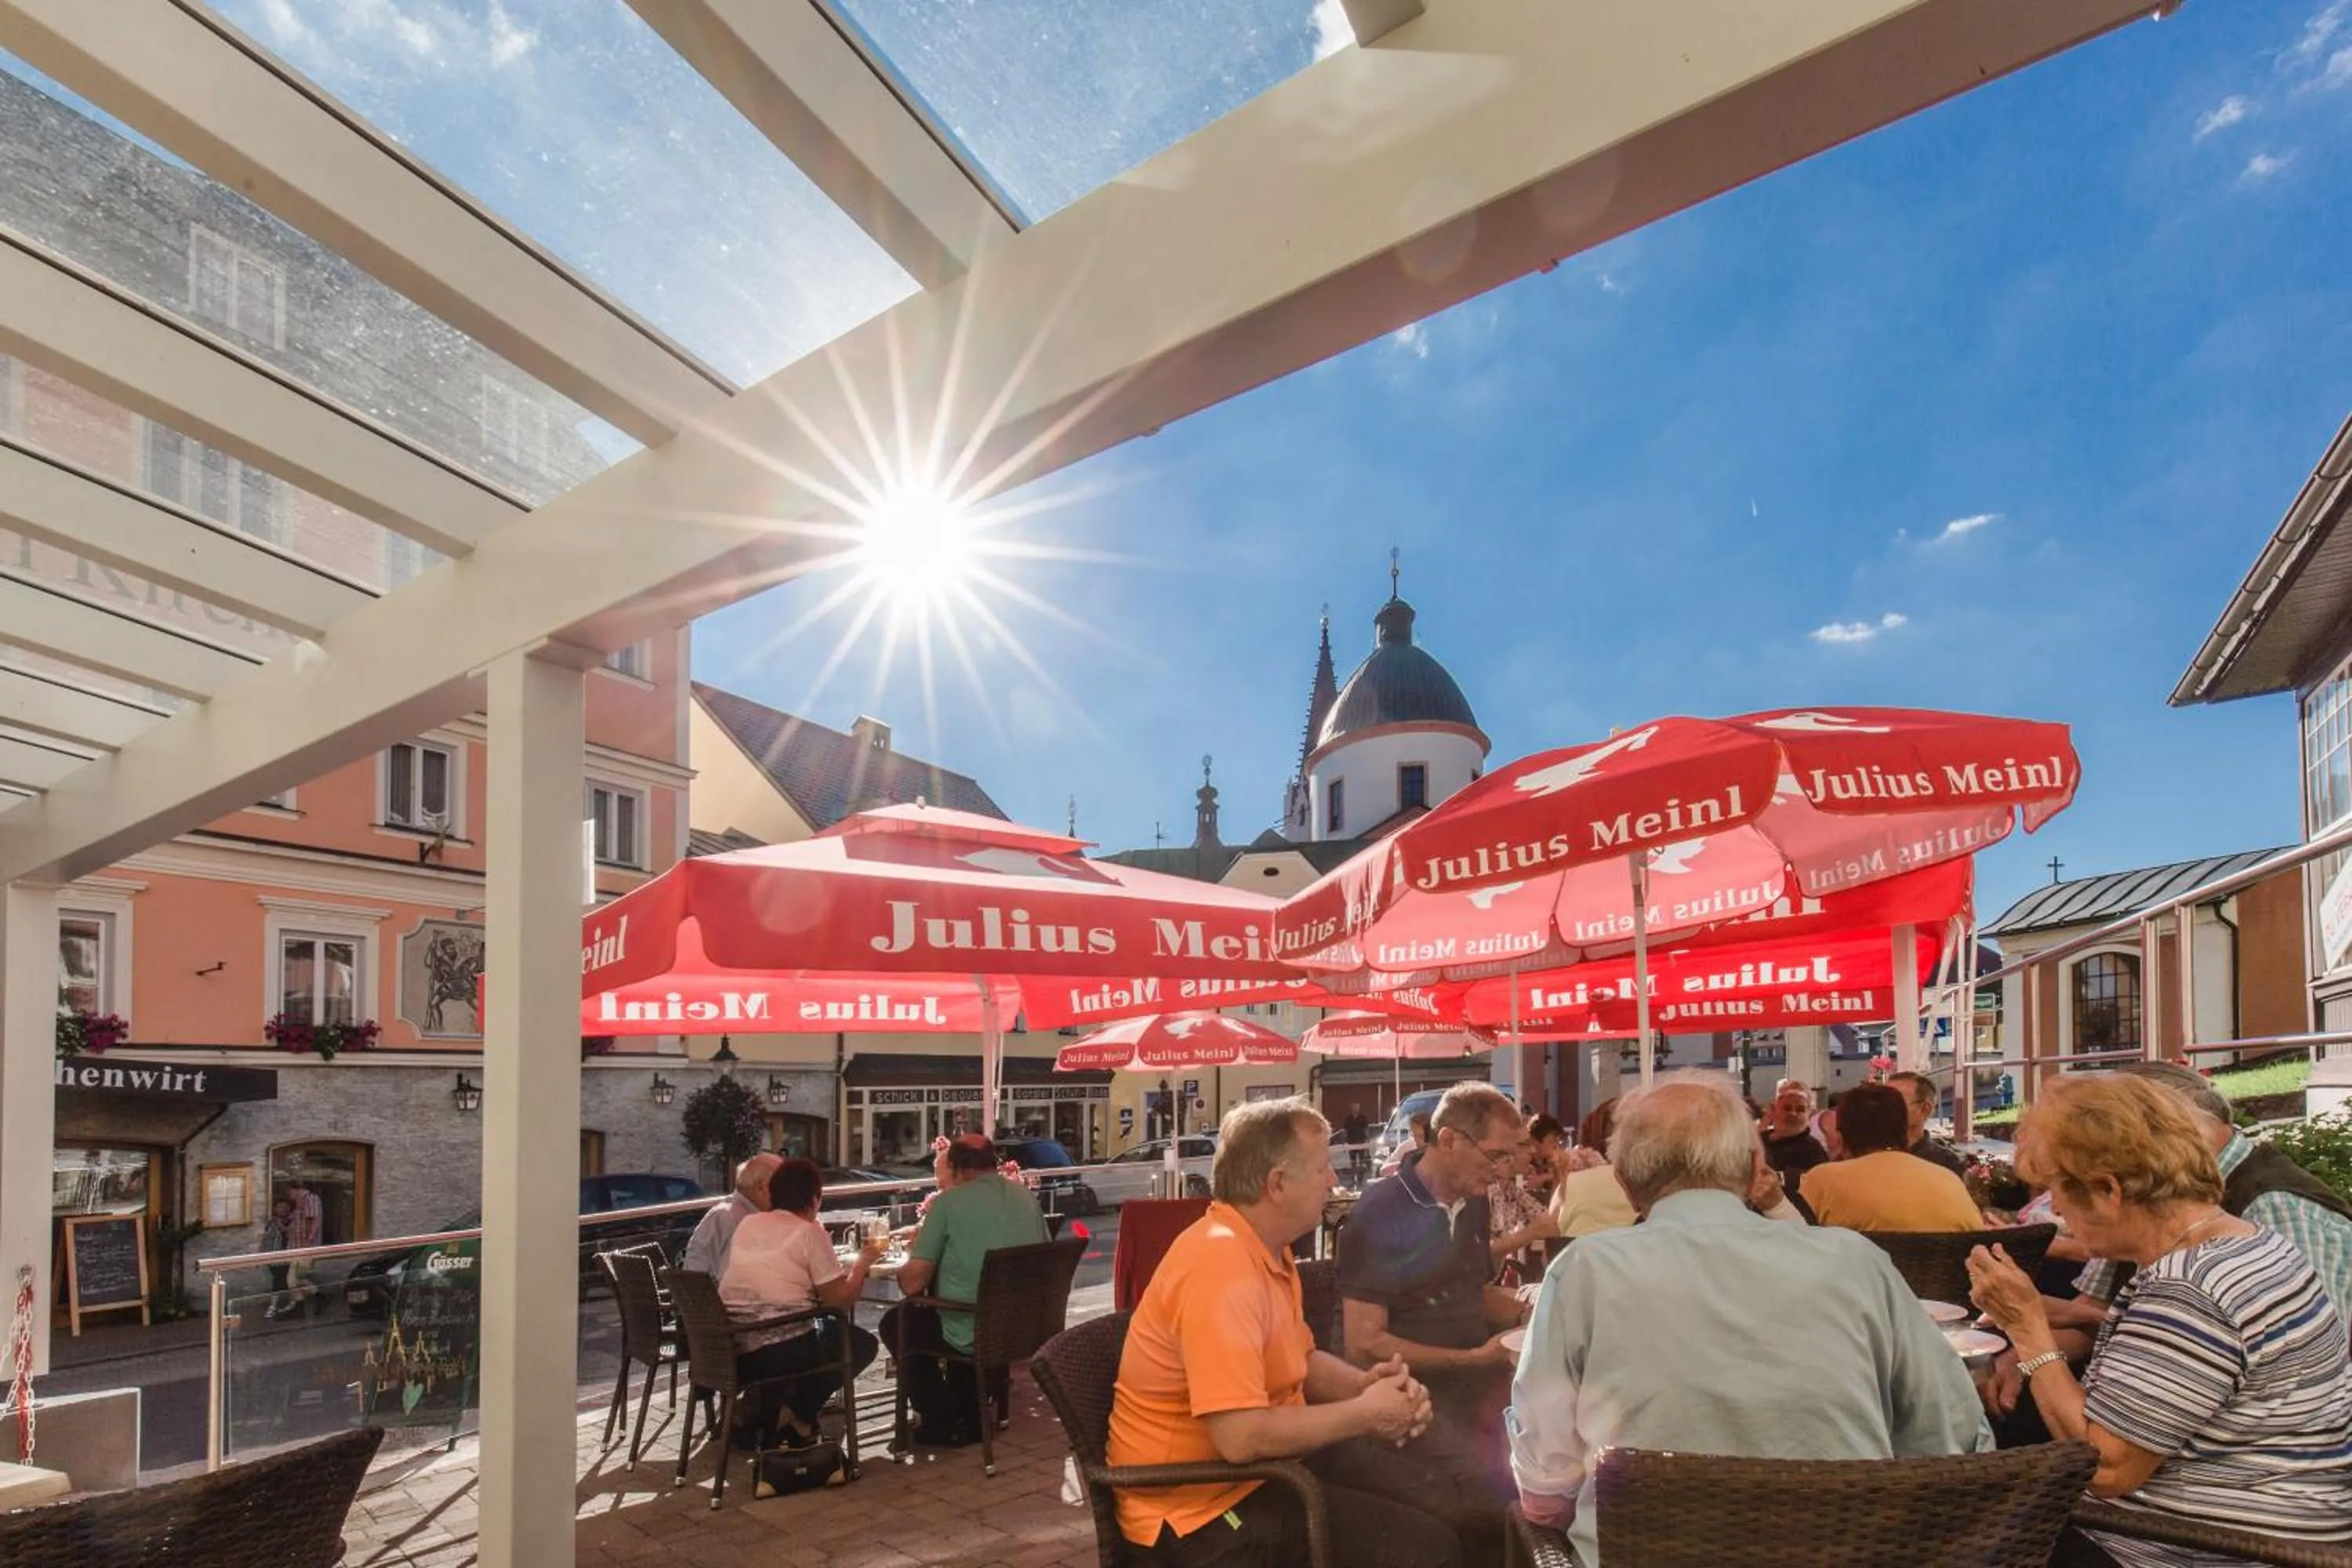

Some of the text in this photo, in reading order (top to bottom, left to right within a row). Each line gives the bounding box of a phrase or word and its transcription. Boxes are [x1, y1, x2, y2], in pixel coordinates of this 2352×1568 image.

[1806, 756, 2064, 804] Julius Meinl
[1417, 786, 1748, 888] Julius Meinl
[870, 901, 1118, 955] Julius
[1275, 916, 1338, 954] Julius
[1781, 989, 1875, 1013] Meinl
[1142, 1046, 1235, 1063] Julius Meinl
[55, 1058, 208, 1093] henwirt
[1186, 1081, 1196, 1092] P
